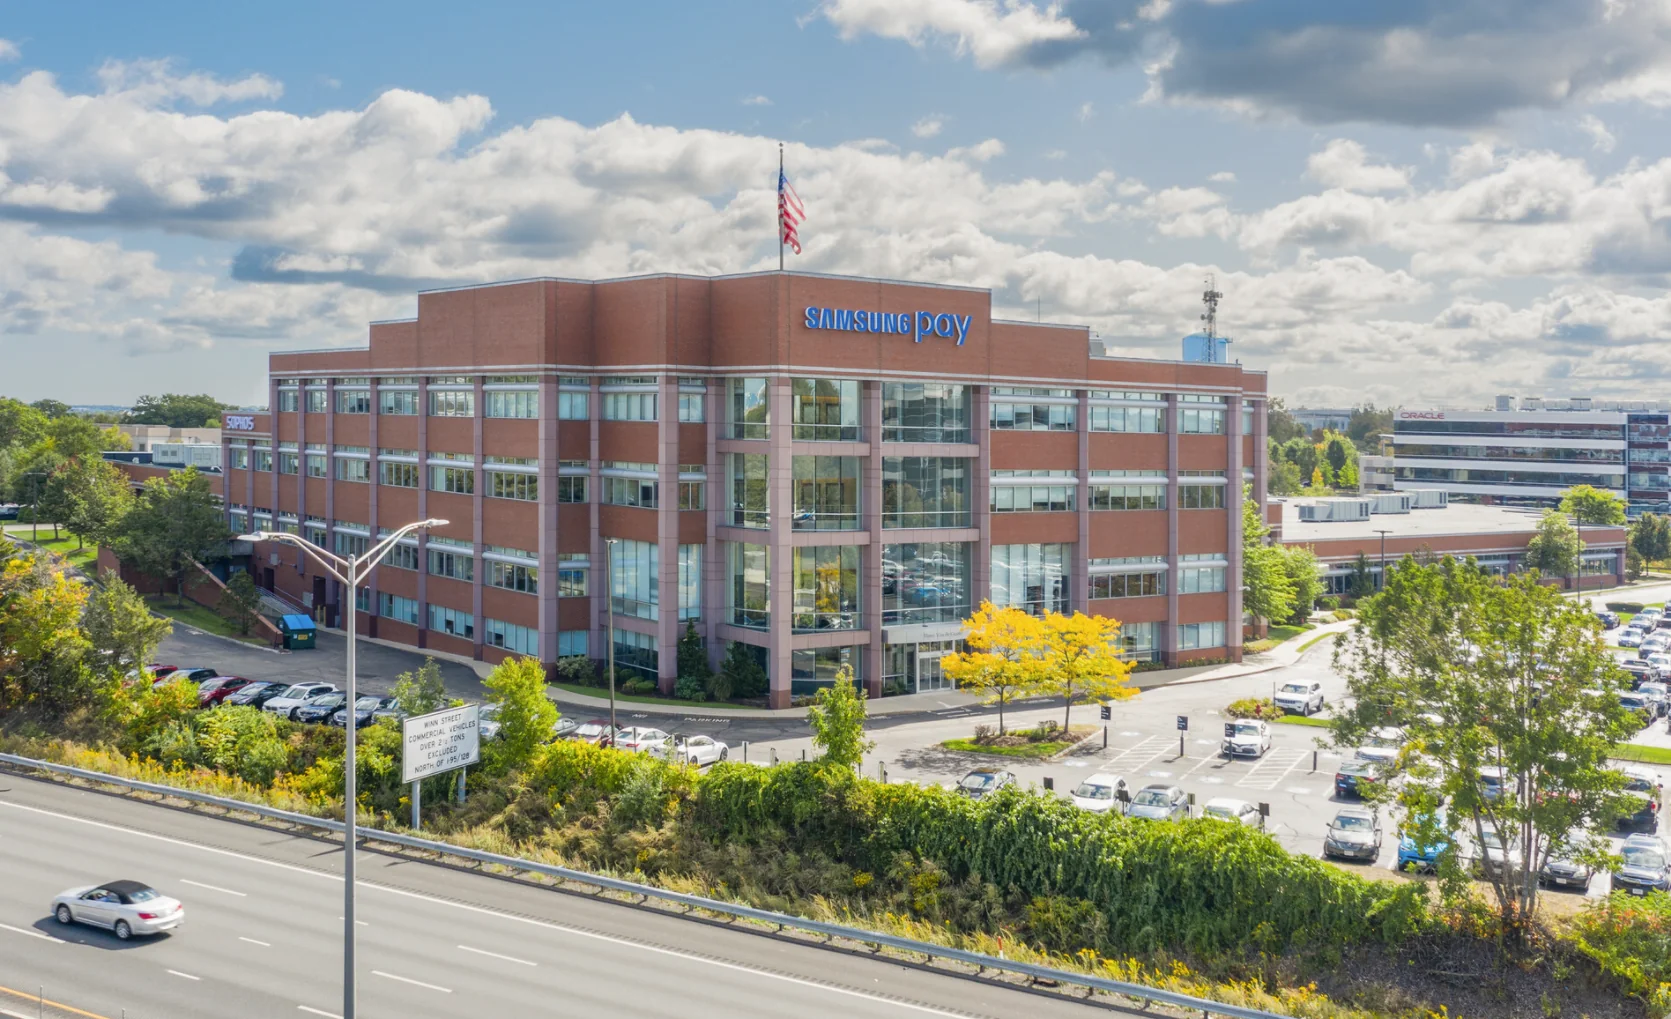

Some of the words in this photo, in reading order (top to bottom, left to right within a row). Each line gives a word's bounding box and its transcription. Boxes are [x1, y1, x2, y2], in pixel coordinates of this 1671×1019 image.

[805, 306, 911, 335] SAMSUNG
[914, 310, 973, 346] pay
[226, 415, 255, 430] SOPHOS
[1400, 411, 1445, 420] ORACLE
[424, 718, 438, 728] WINN
[441, 713, 462, 725] STREET
[408, 728, 446, 743] COMMERCIAL
[449, 720, 476, 733] VEHICLES
[420, 740, 436, 751] OVER
[450, 733, 465, 743] TONS
[427, 745, 458, 760] EXCLUDED
[415, 762, 435, 774] NORTH
[436, 759, 444, 768] OF
